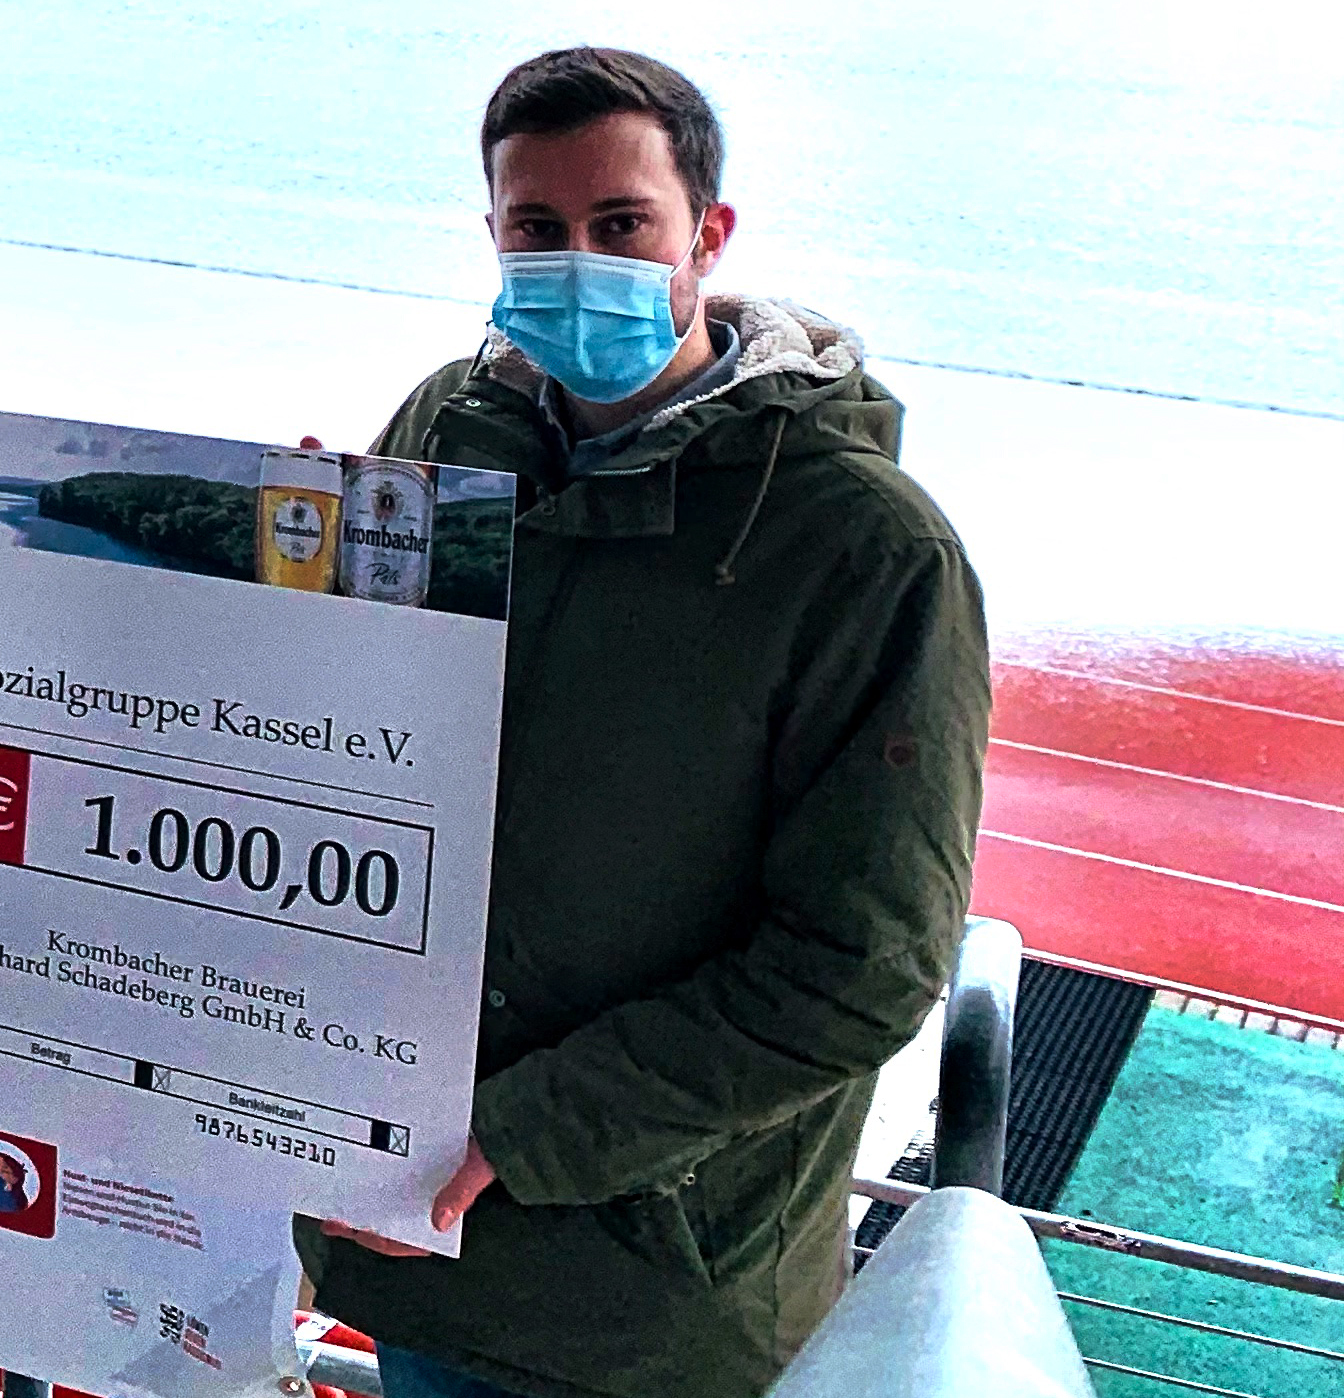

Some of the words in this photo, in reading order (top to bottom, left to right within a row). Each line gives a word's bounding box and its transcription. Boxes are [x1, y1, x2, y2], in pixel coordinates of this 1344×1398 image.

[343, 520, 429, 554] Krombacher
[212, 699, 333, 753] Kassel
[344, 729, 415, 767] e.V.
[84, 795, 400, 917] 1.000,00
[47, 930, 194, 984] Krombacher
[201, 966, 306, 1010] Brauerei
[57, 964, 195, 1018] Schadeberg
[202, 996, 286, 1035] GmbH
[293, 1017, 315, 1040] &
[323, 1024, 365, 1053] Co.
[374, 1034, 419, 1066] KG
[30, 1042, 73, 1065] Betrag
[229, 1092, 306, 1123] Bankleitzahl
[194, 1113, 336, 1167] 9876543210
